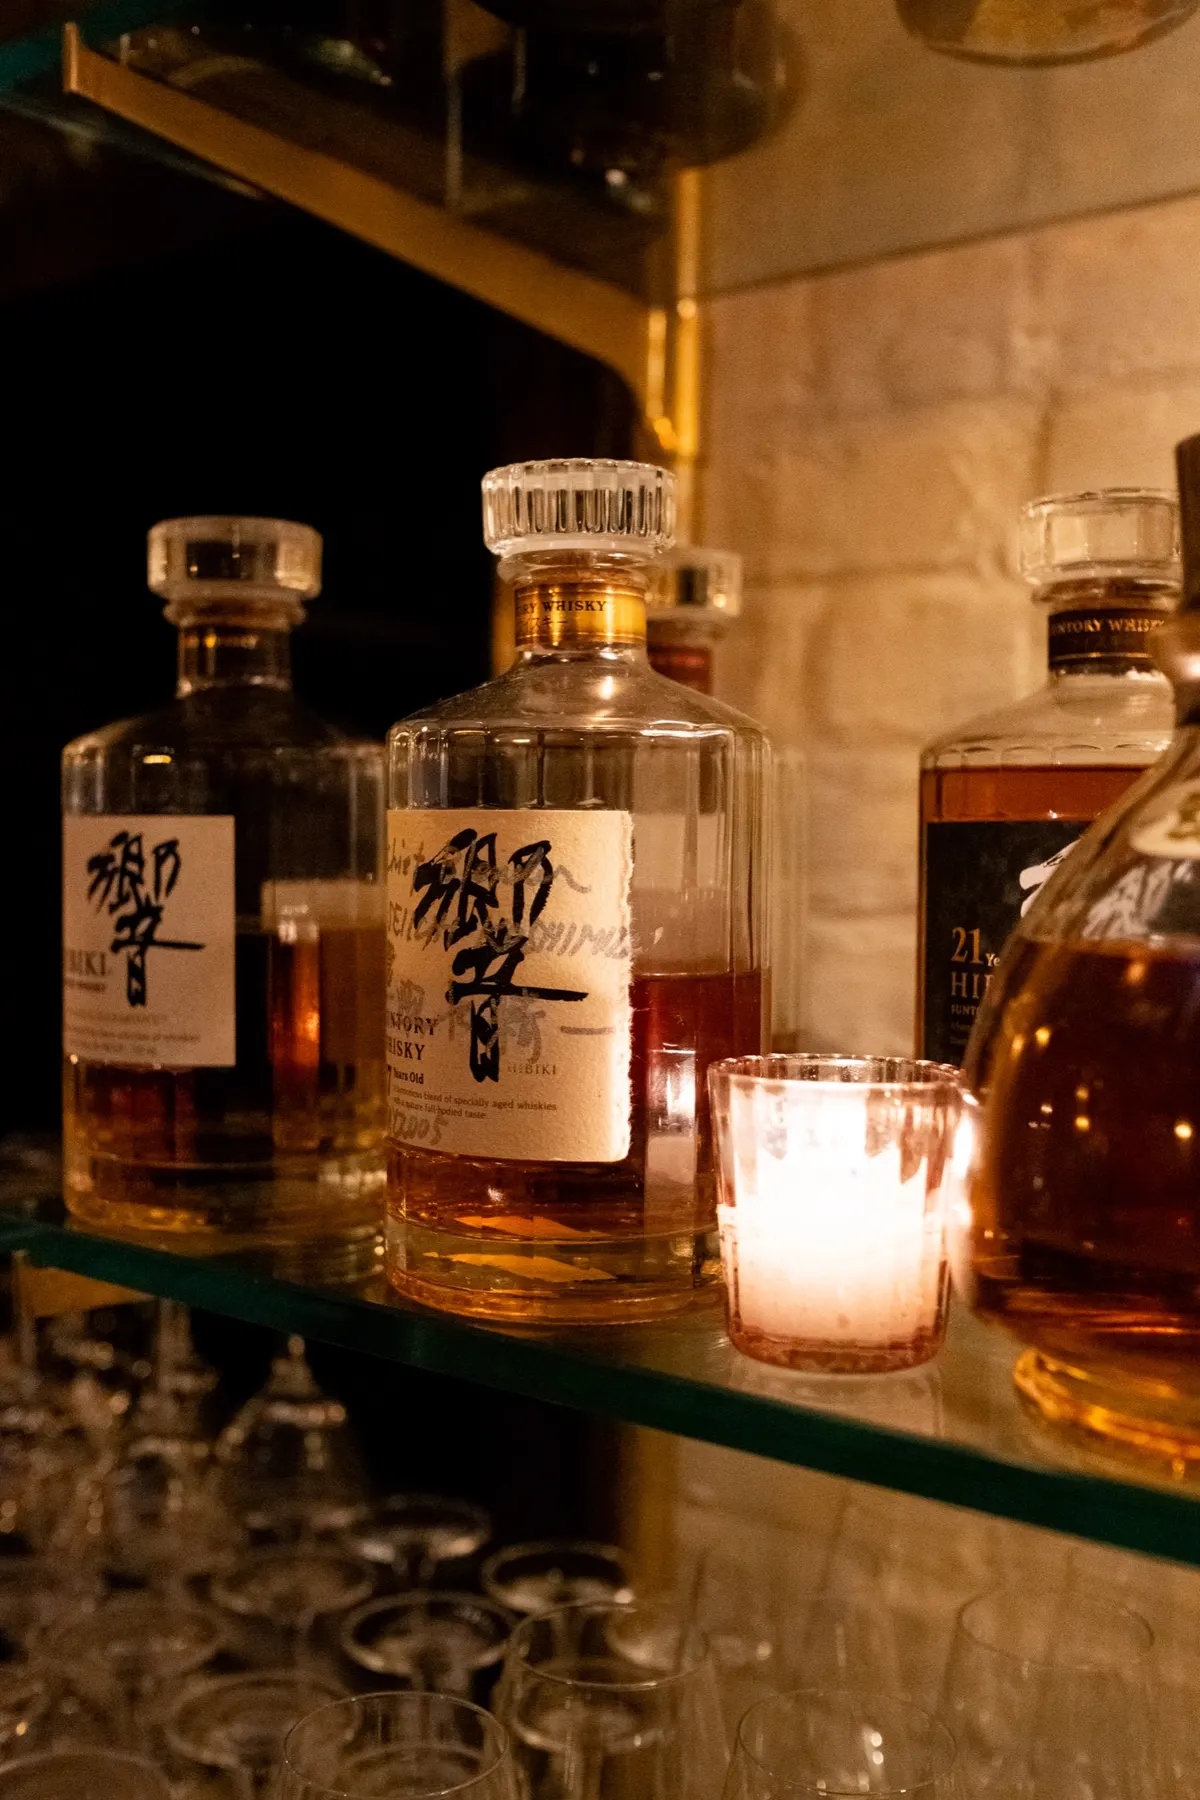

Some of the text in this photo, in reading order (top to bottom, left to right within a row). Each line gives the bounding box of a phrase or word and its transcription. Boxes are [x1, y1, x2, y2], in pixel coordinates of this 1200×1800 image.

[543, 600, 607, 612] WHISKY
[951, 926, 1001, 967] 21 Ye
[387, 1010, 437, 1036] NTORY
[409, 1071, 424, 1085] Old
[453, 1096, 490, 1109] specially
[491, 1098, 516, 1111] aged
[517, 1100, 557, 1111] whiskies
[465, 1109, 486, 1119] taste
